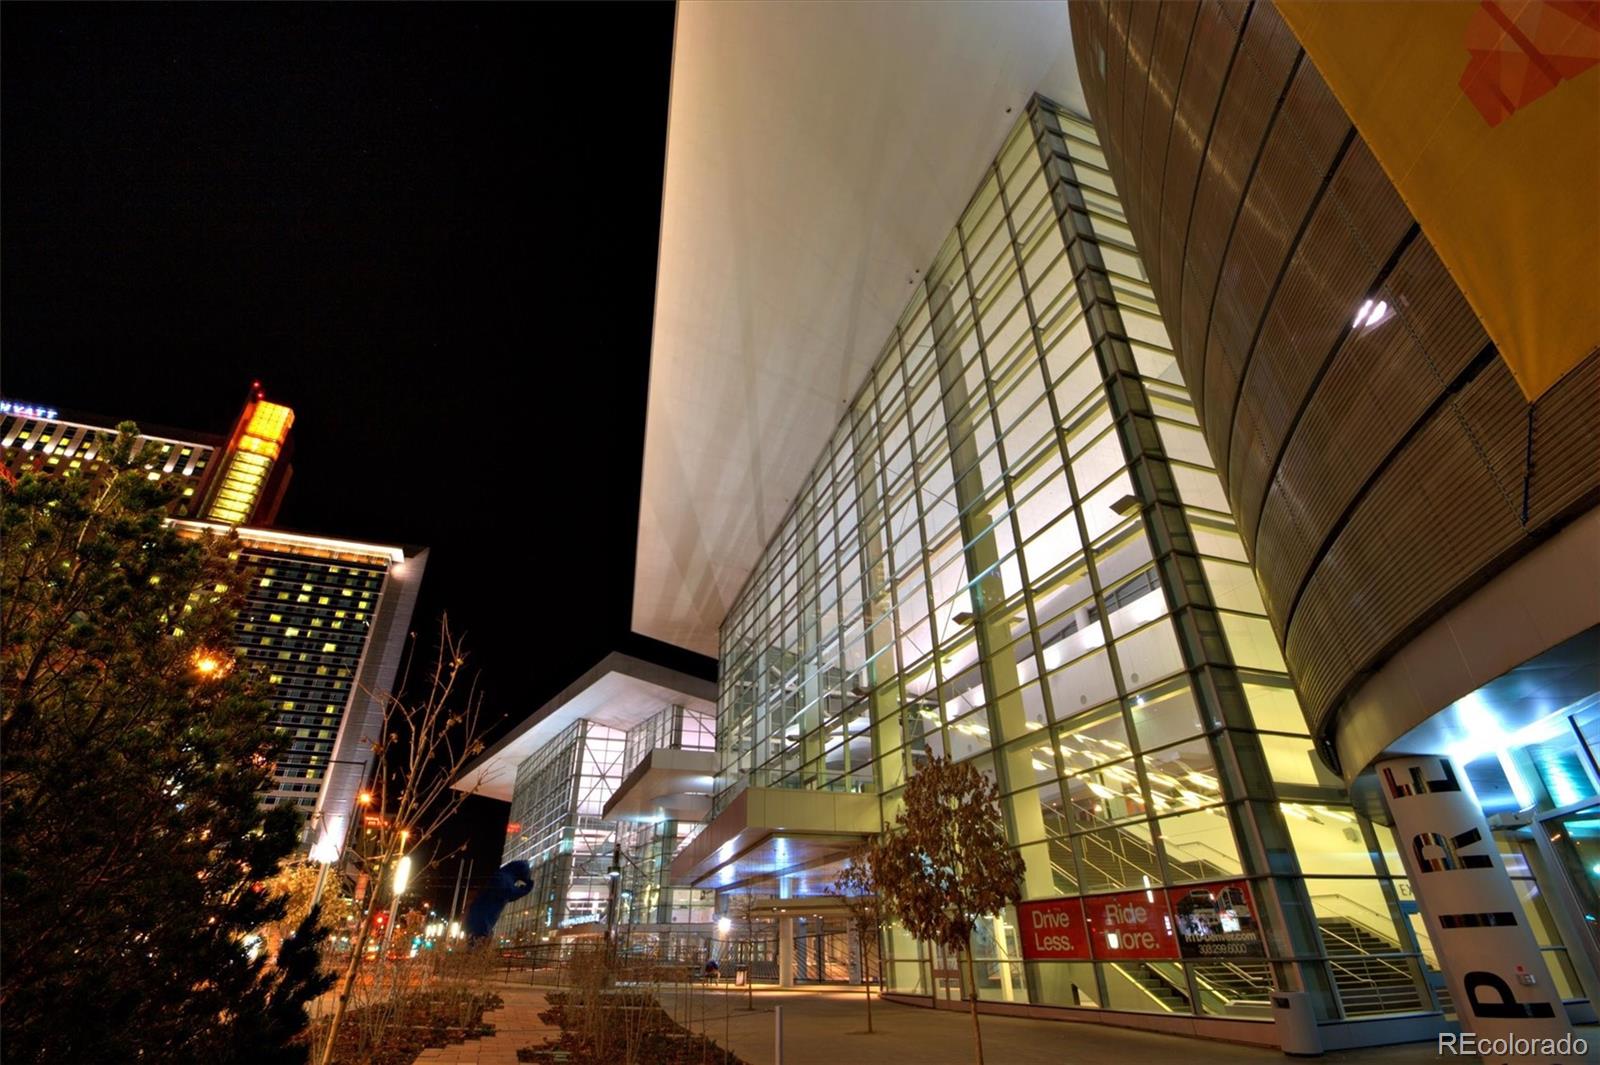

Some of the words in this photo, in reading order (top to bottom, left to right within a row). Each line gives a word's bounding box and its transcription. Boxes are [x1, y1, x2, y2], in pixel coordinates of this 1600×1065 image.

[0, 401, 58, 419] HYATT
[1032, 909, 1070, 929] Drive
[1105, 903, 1148, 926] Ride
[1383, 759, 1556, 1065] PIRE
[1034, 932, 1075, 952] Less.
[1105, 929, 1160, 950] More.
